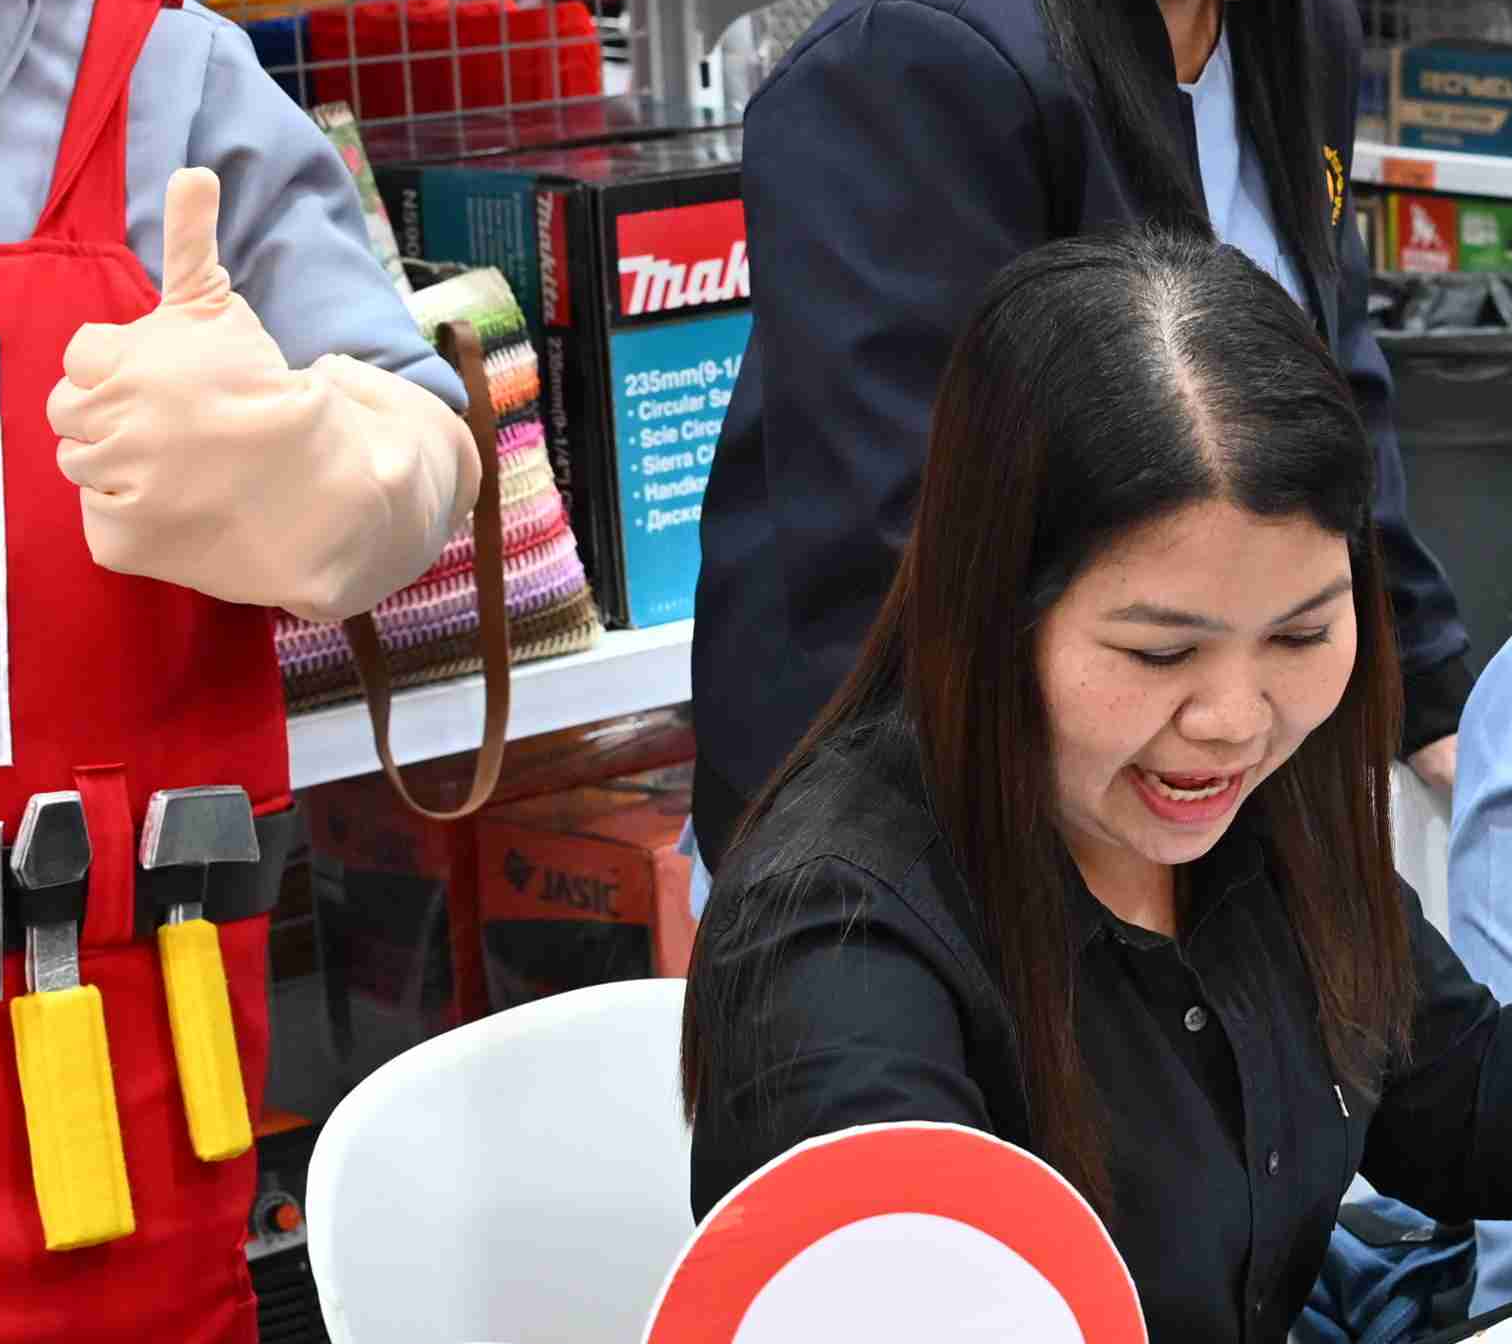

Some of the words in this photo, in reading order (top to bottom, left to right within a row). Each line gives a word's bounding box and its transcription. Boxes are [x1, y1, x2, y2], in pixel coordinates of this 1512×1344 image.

[624, 353, 743, 397] 235mm(9-1/
[638, 392, 706, 421] Circular
[708, 387, 732, 408] Sa
[640, 425, 680, 449] Scie
[681, 418, 723, 441] Circ
[642, 450, 694, 476] Sierra
[647, 504, 703, 533] Диско
